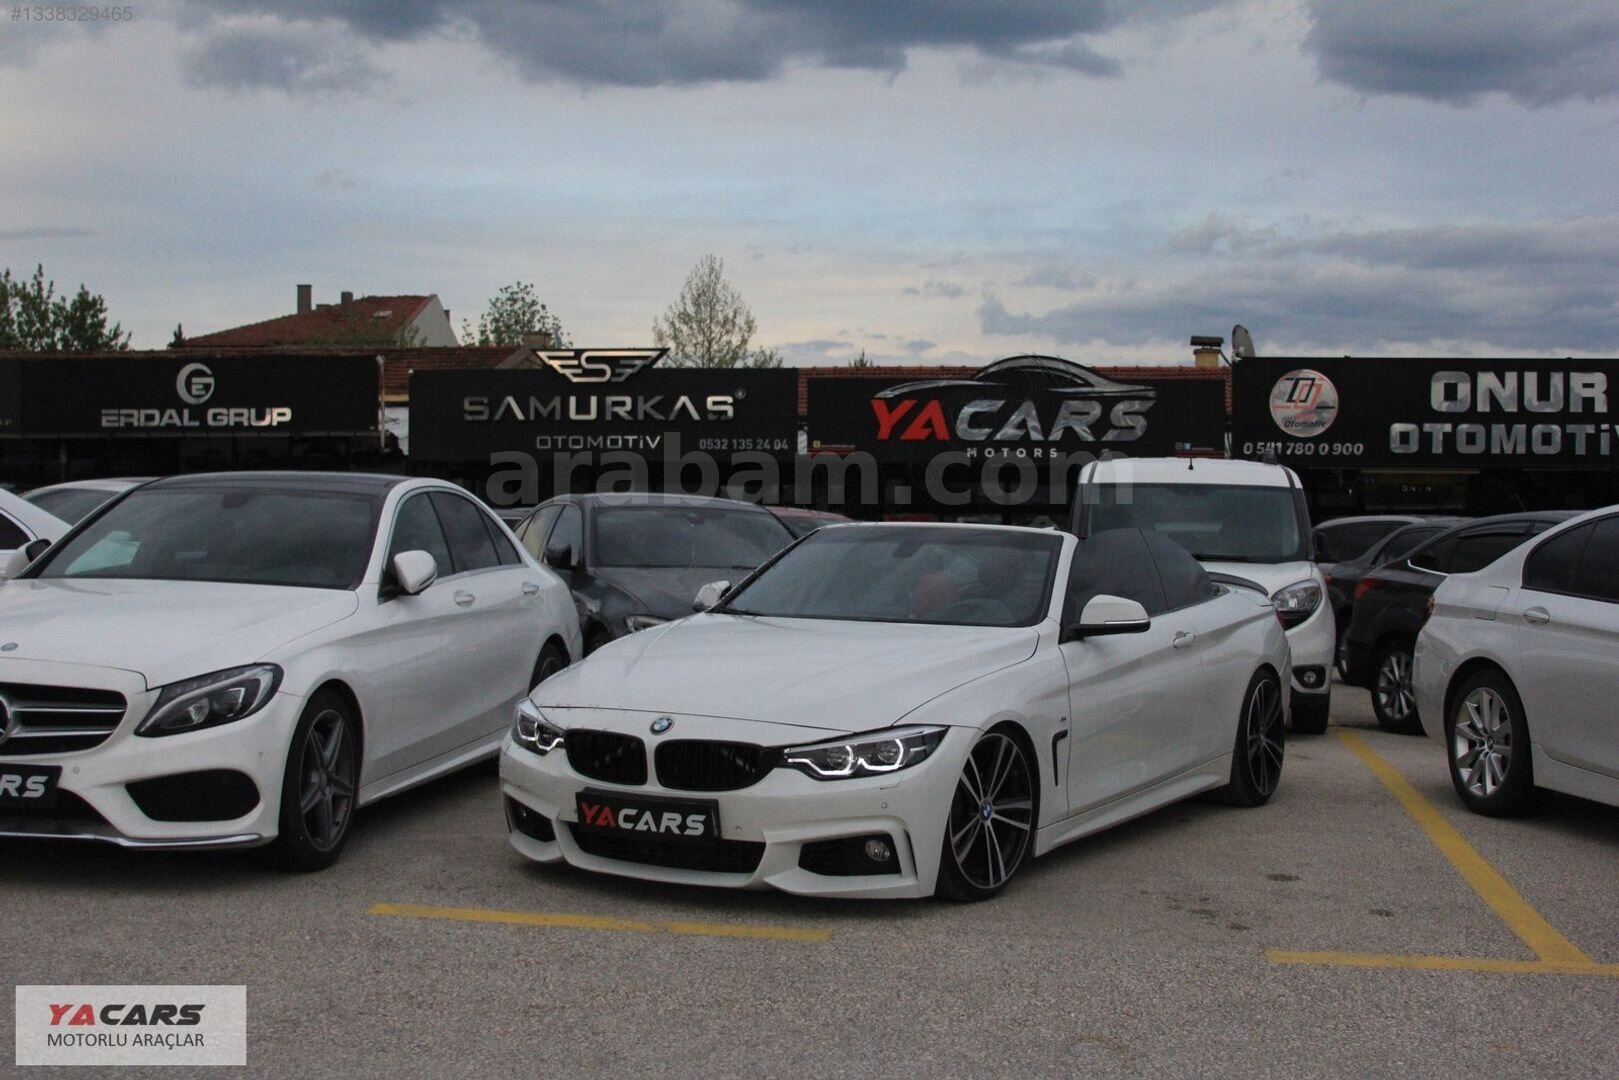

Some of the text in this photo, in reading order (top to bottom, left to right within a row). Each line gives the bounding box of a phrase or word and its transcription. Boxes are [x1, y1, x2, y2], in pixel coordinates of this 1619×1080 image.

[1430, 371, 1608, 413] ONUR
[101, 407, 292, 427] ERDAL GRUP
[463, 395, 734, 421] SAMURKAS
[871, 399, 1156, 442] YACARS
[699, 438, 788, 450] 0532 135 24 04
[966, 447, 1058, 458] MOTORS
[1243, 442, 1254, 455] 0
[1286, 442, 1315, 455] 780
[1318, 442, 1329, 455] 0
[1332, 442, 1364, 455] 900
[581, 803, 706, 836] YACARS
